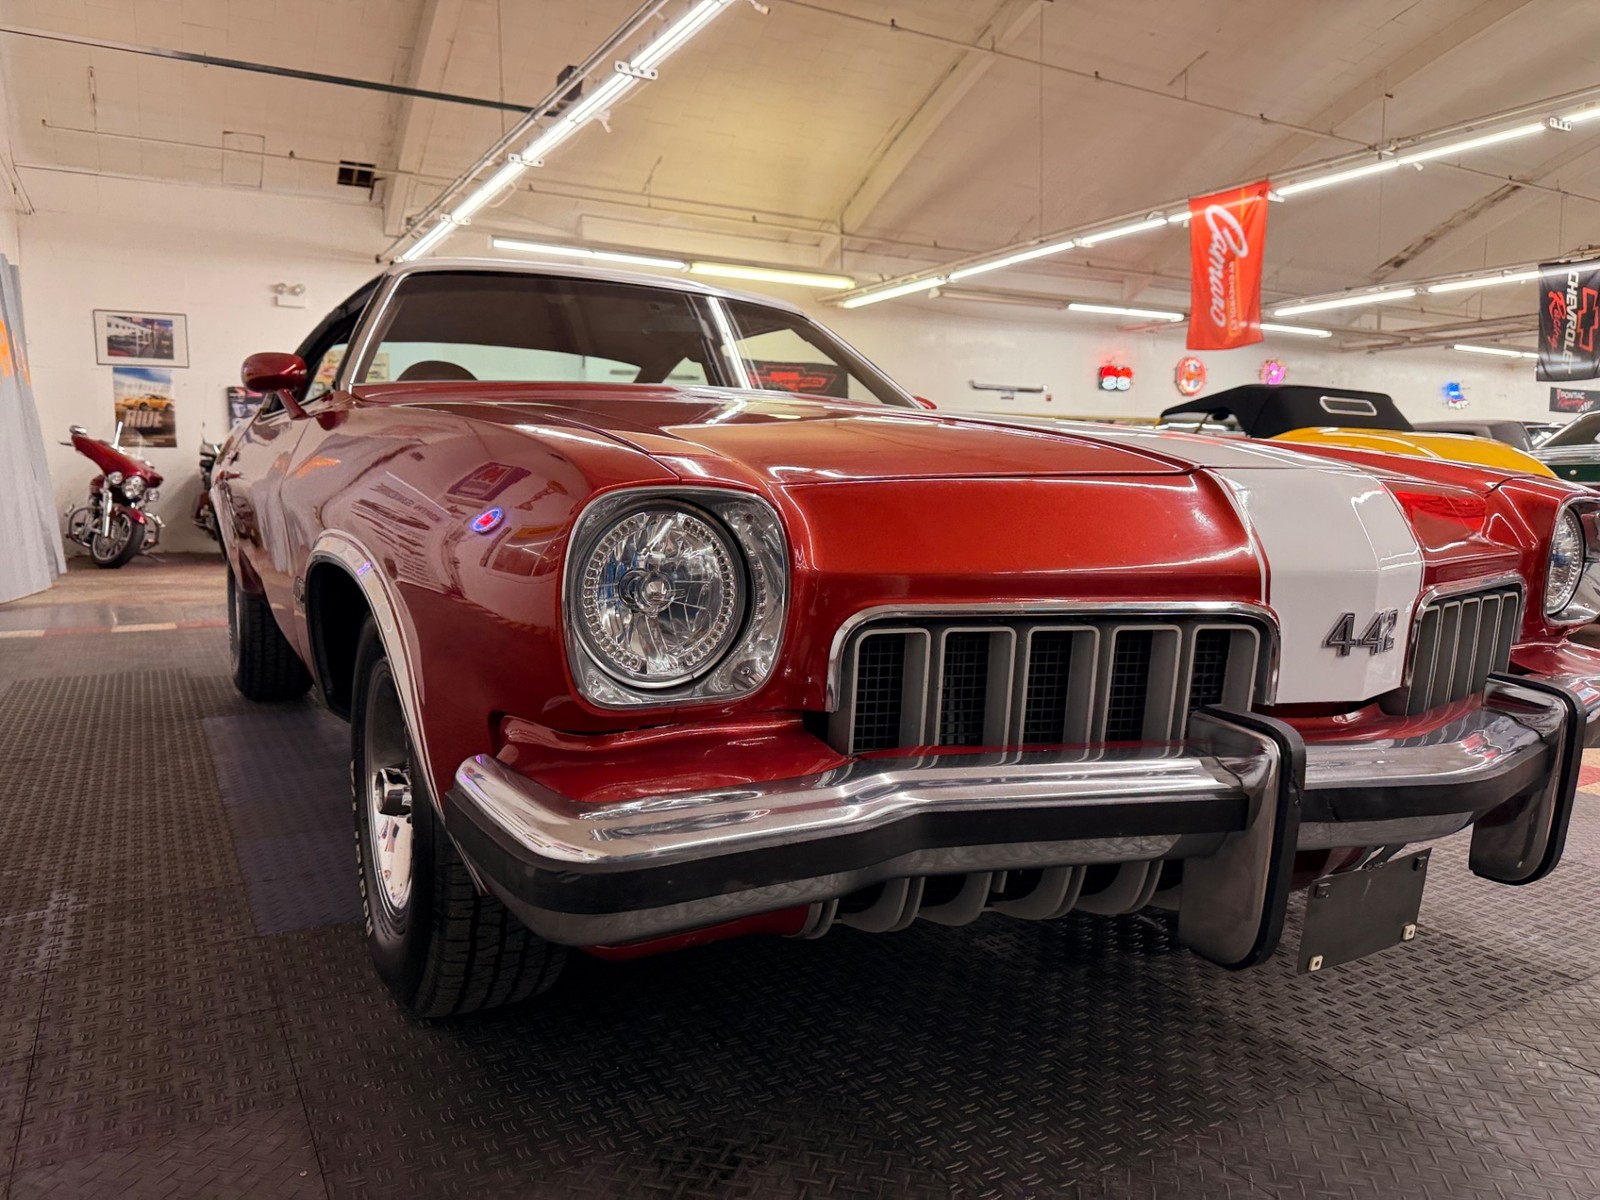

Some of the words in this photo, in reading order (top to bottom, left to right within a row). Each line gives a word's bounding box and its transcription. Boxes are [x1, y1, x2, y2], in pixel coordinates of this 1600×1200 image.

[1205, 204, 1248, 328] Camaro
[1548, 291, 1567, 351] Racing
[1563, 270, 1579, 374] CHEVROLET
[124, 410, 163, 427] RIDE
[1560, 390, 1585, 399] PONTIAC
